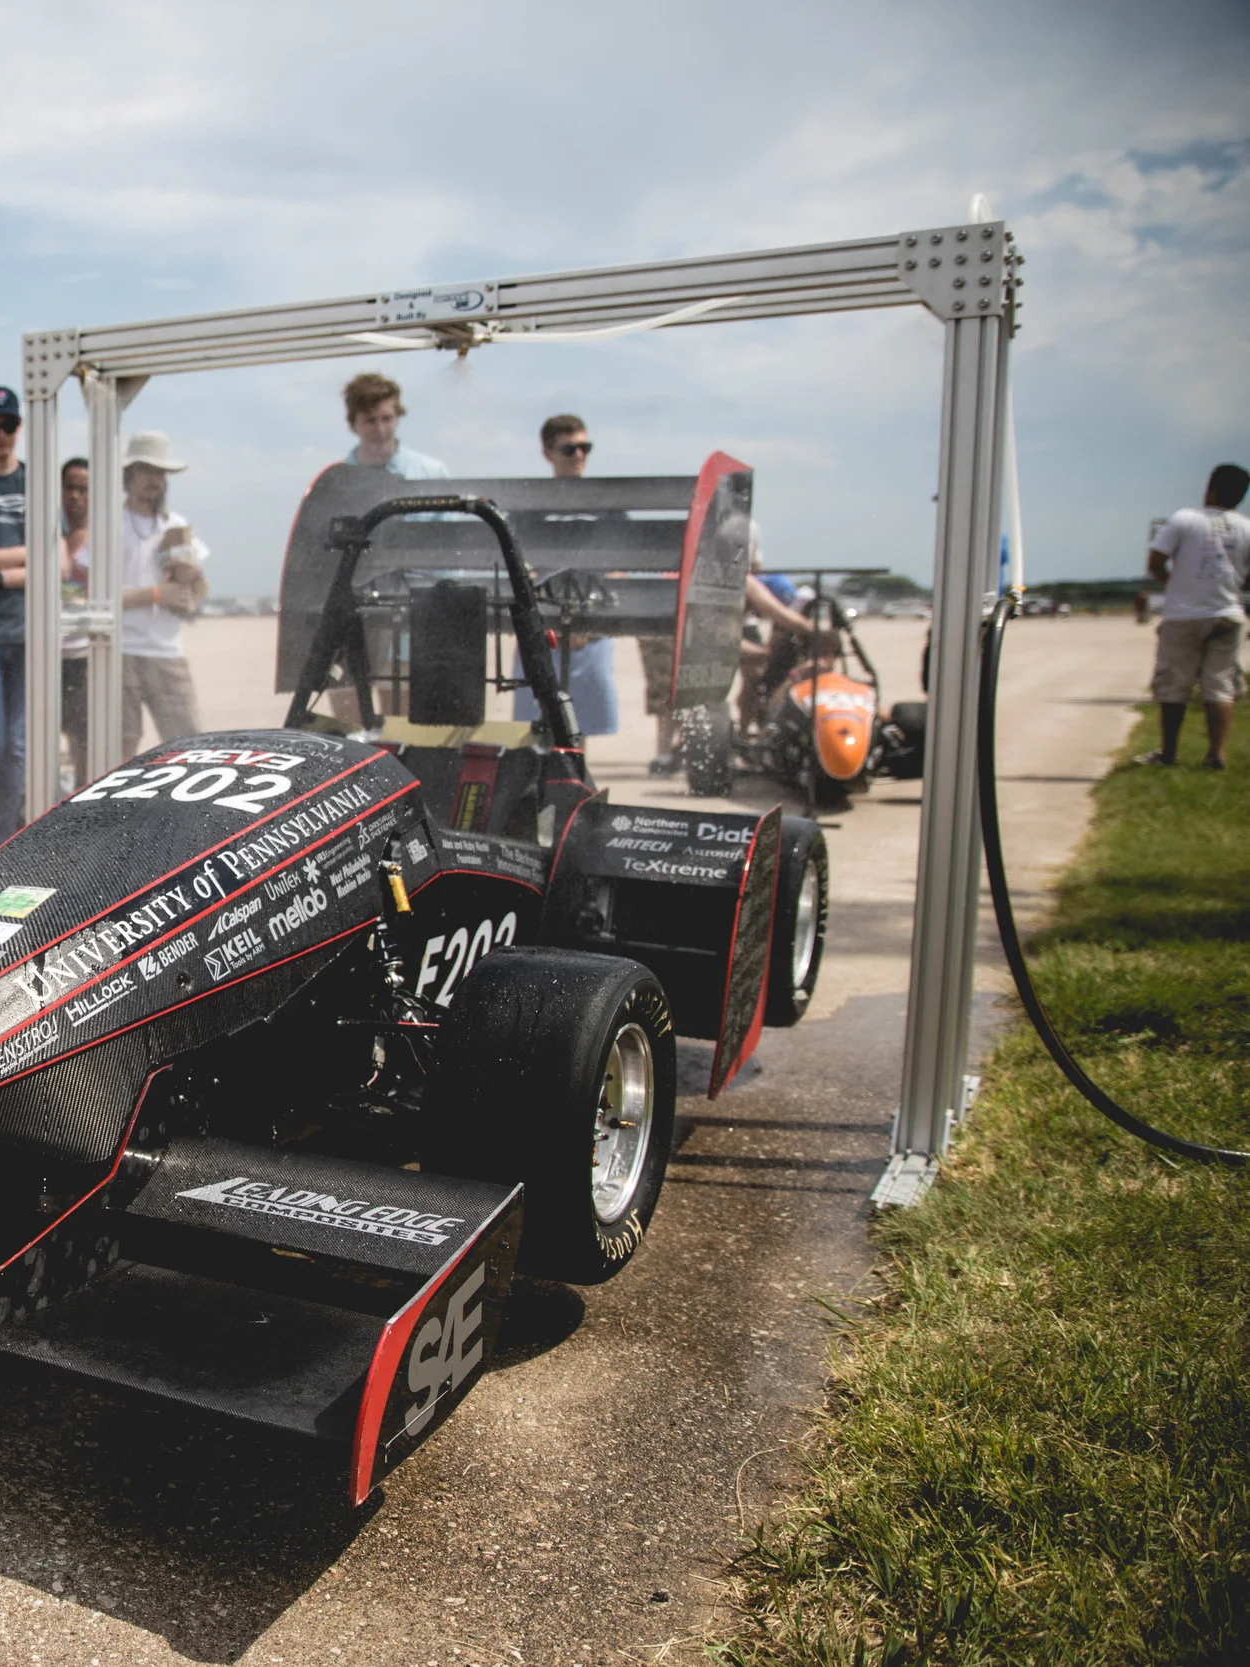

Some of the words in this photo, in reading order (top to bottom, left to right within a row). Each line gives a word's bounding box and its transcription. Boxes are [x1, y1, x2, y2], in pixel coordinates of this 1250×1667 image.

[396, 312, 414, 321] Built
[70, 765, 292, 815] E202
[634, 815, 689, 829] Northern
[696, 822, 755, 844] Diab
[605, 837, 673, 853] AIRTECH
[622, 856, 728, 879] TeXtreme
[12, 885, 192, 1011] UNIVERSITY
[193, 860, 227, 900] of
[217, 783, 372, 880] PENNSYLVANIA
[221, 896, 263, 931] Calspan
[157, 931, 199, 968] BENDER
[222, 927, 263, 962] KEIL
[65, 972, 134, 1021] HILLOCK
[216, 1177, 371, 1214] LEADING
[361, 1205, 466, 1233] EDGE
[222, 1196, 438, 1244] COMPOSITES
[404, 1260, 486, 1438] SAE
